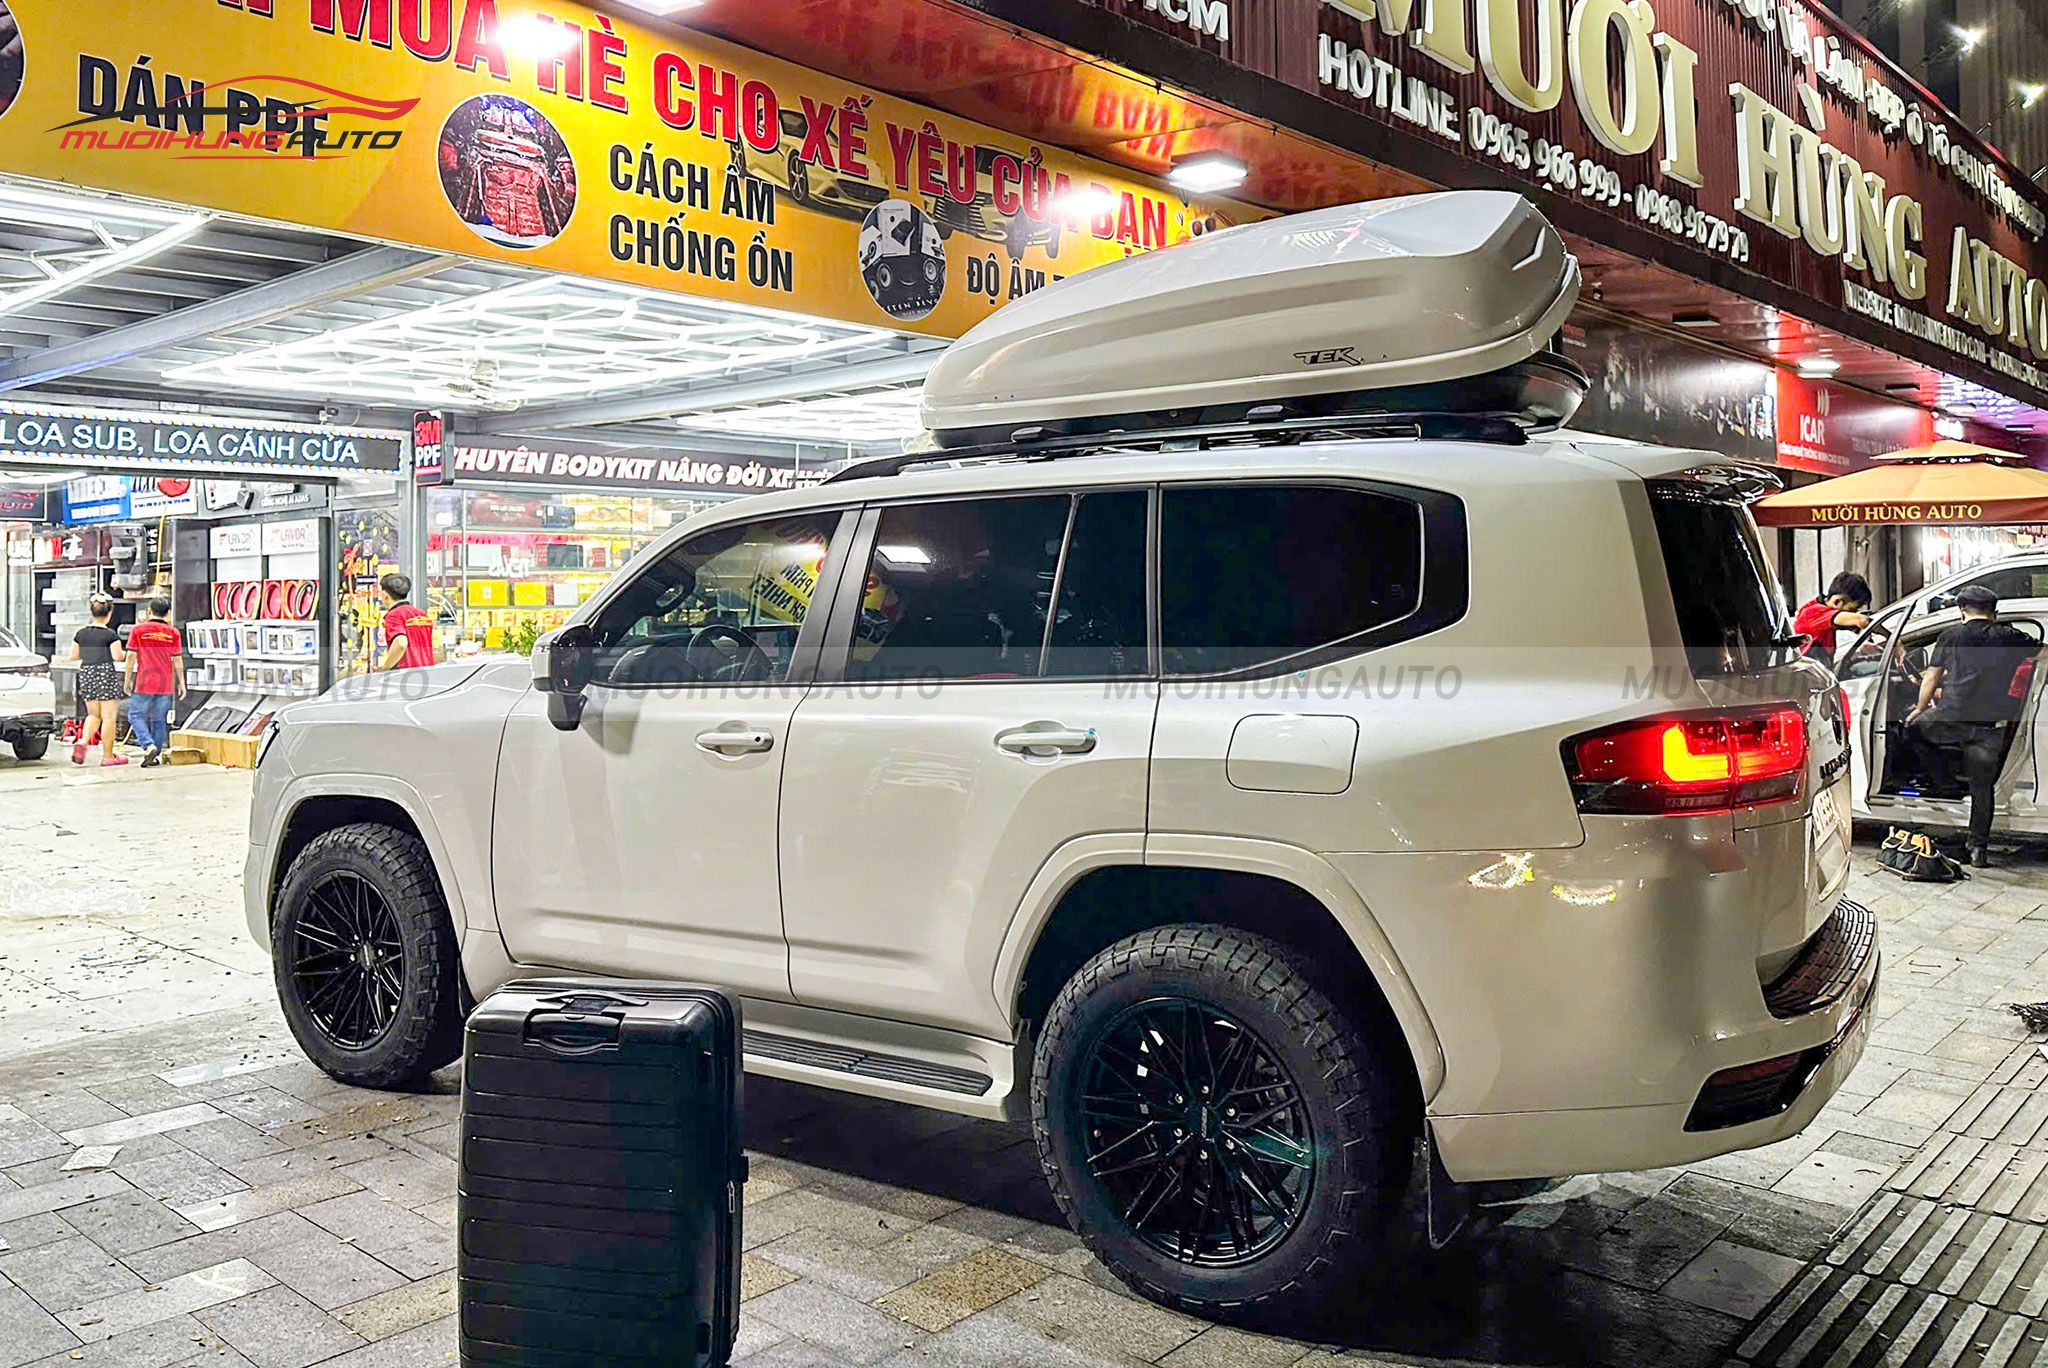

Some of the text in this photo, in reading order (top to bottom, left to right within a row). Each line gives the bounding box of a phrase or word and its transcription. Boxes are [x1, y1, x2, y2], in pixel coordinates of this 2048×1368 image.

[1144, 0, 1229, 42] CM
[78, 53, 206, 137] DÁN
[1779, 2, 1813, 65] VÀ
[1813, 35, 1865, 103] LÀM
[1906, 102, 1924, 145] Ô
[1924, 121, 1950, 166] TÔ
[535, 14, 630, 113] HÈ
[653, 52, 779, 152] CHO
[799, 93, 873, 179] XẾ
[885, 121, 976, 204] YÊU
[1090, 182, 1167, 257] BẠN
[608, 142, 776, 225] CÁCH ÂM
[1468, 107, 1531, 169] 0965
[1533, 138, 1577, 190] 966
[1579, 159, 1622, 207] 999
[1635, 183, 1684, 234] 0968
[1683, 205, 1749, 262] 967979
[1728, 82, 1928, 300] HÙNG
[1946, 226, 2048, 360] AUTO
[608, 208, 793, 293] CHỐNG ỒN
[967, 253, 1045, 305] ĐỘ ÂM
[1293, 346, 1361, 366] TEK
[0, 419, 360, 464] LOA SUB, LOA CÁNH CỬA
[415, 420, 440, 446] 3M
[1800, 414, 1826, 445] ICAR
[415, 444, 441, 468] PPF
[550, 453, 658, 480] BODYKIT
[657, 456, 723, 485] NÂNG
[726, 460, 766, 487] ĐỜI
[1811, 503, 1982, 521] MƯỜI HÙNG AUTO
